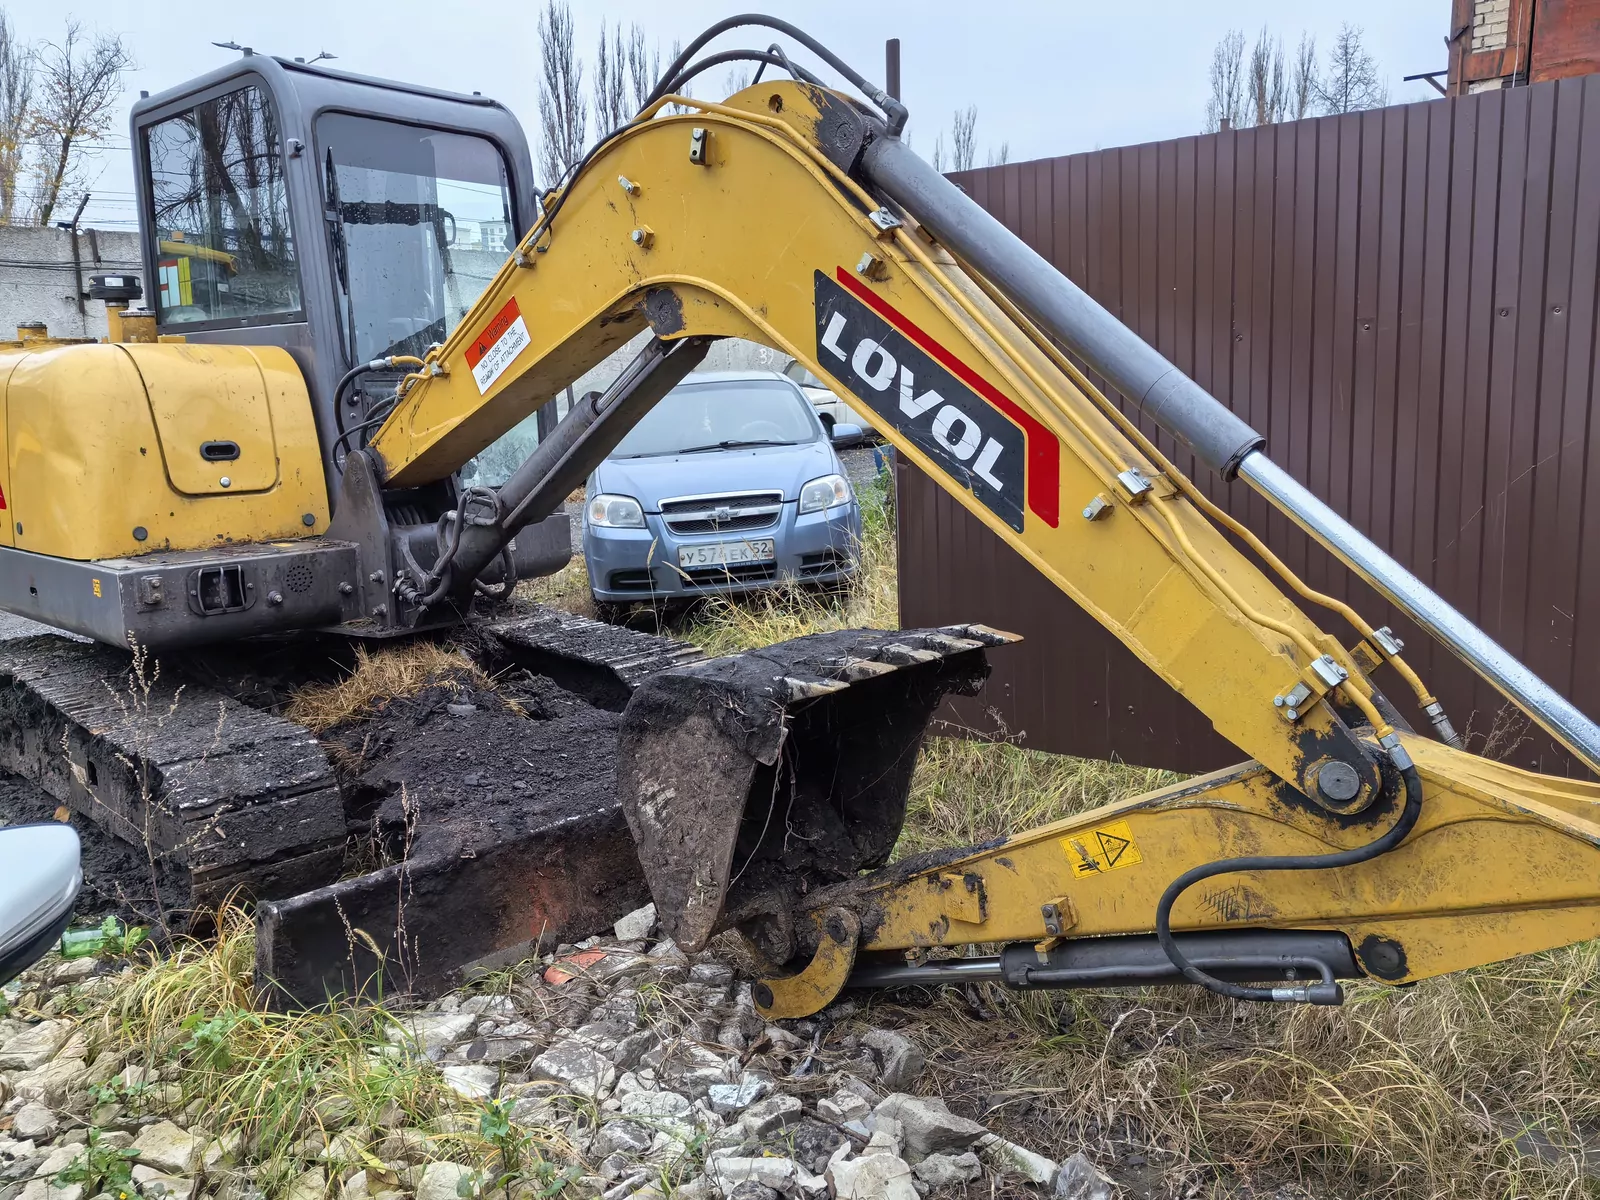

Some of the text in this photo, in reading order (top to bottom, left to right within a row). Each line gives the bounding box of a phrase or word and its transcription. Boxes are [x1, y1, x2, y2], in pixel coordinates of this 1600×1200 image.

[481, 326, 518, 371] NO CLOSE TO THE
[487, 315, 509, 340] Warning
[821, 311, 1004, 492] LOVOL
